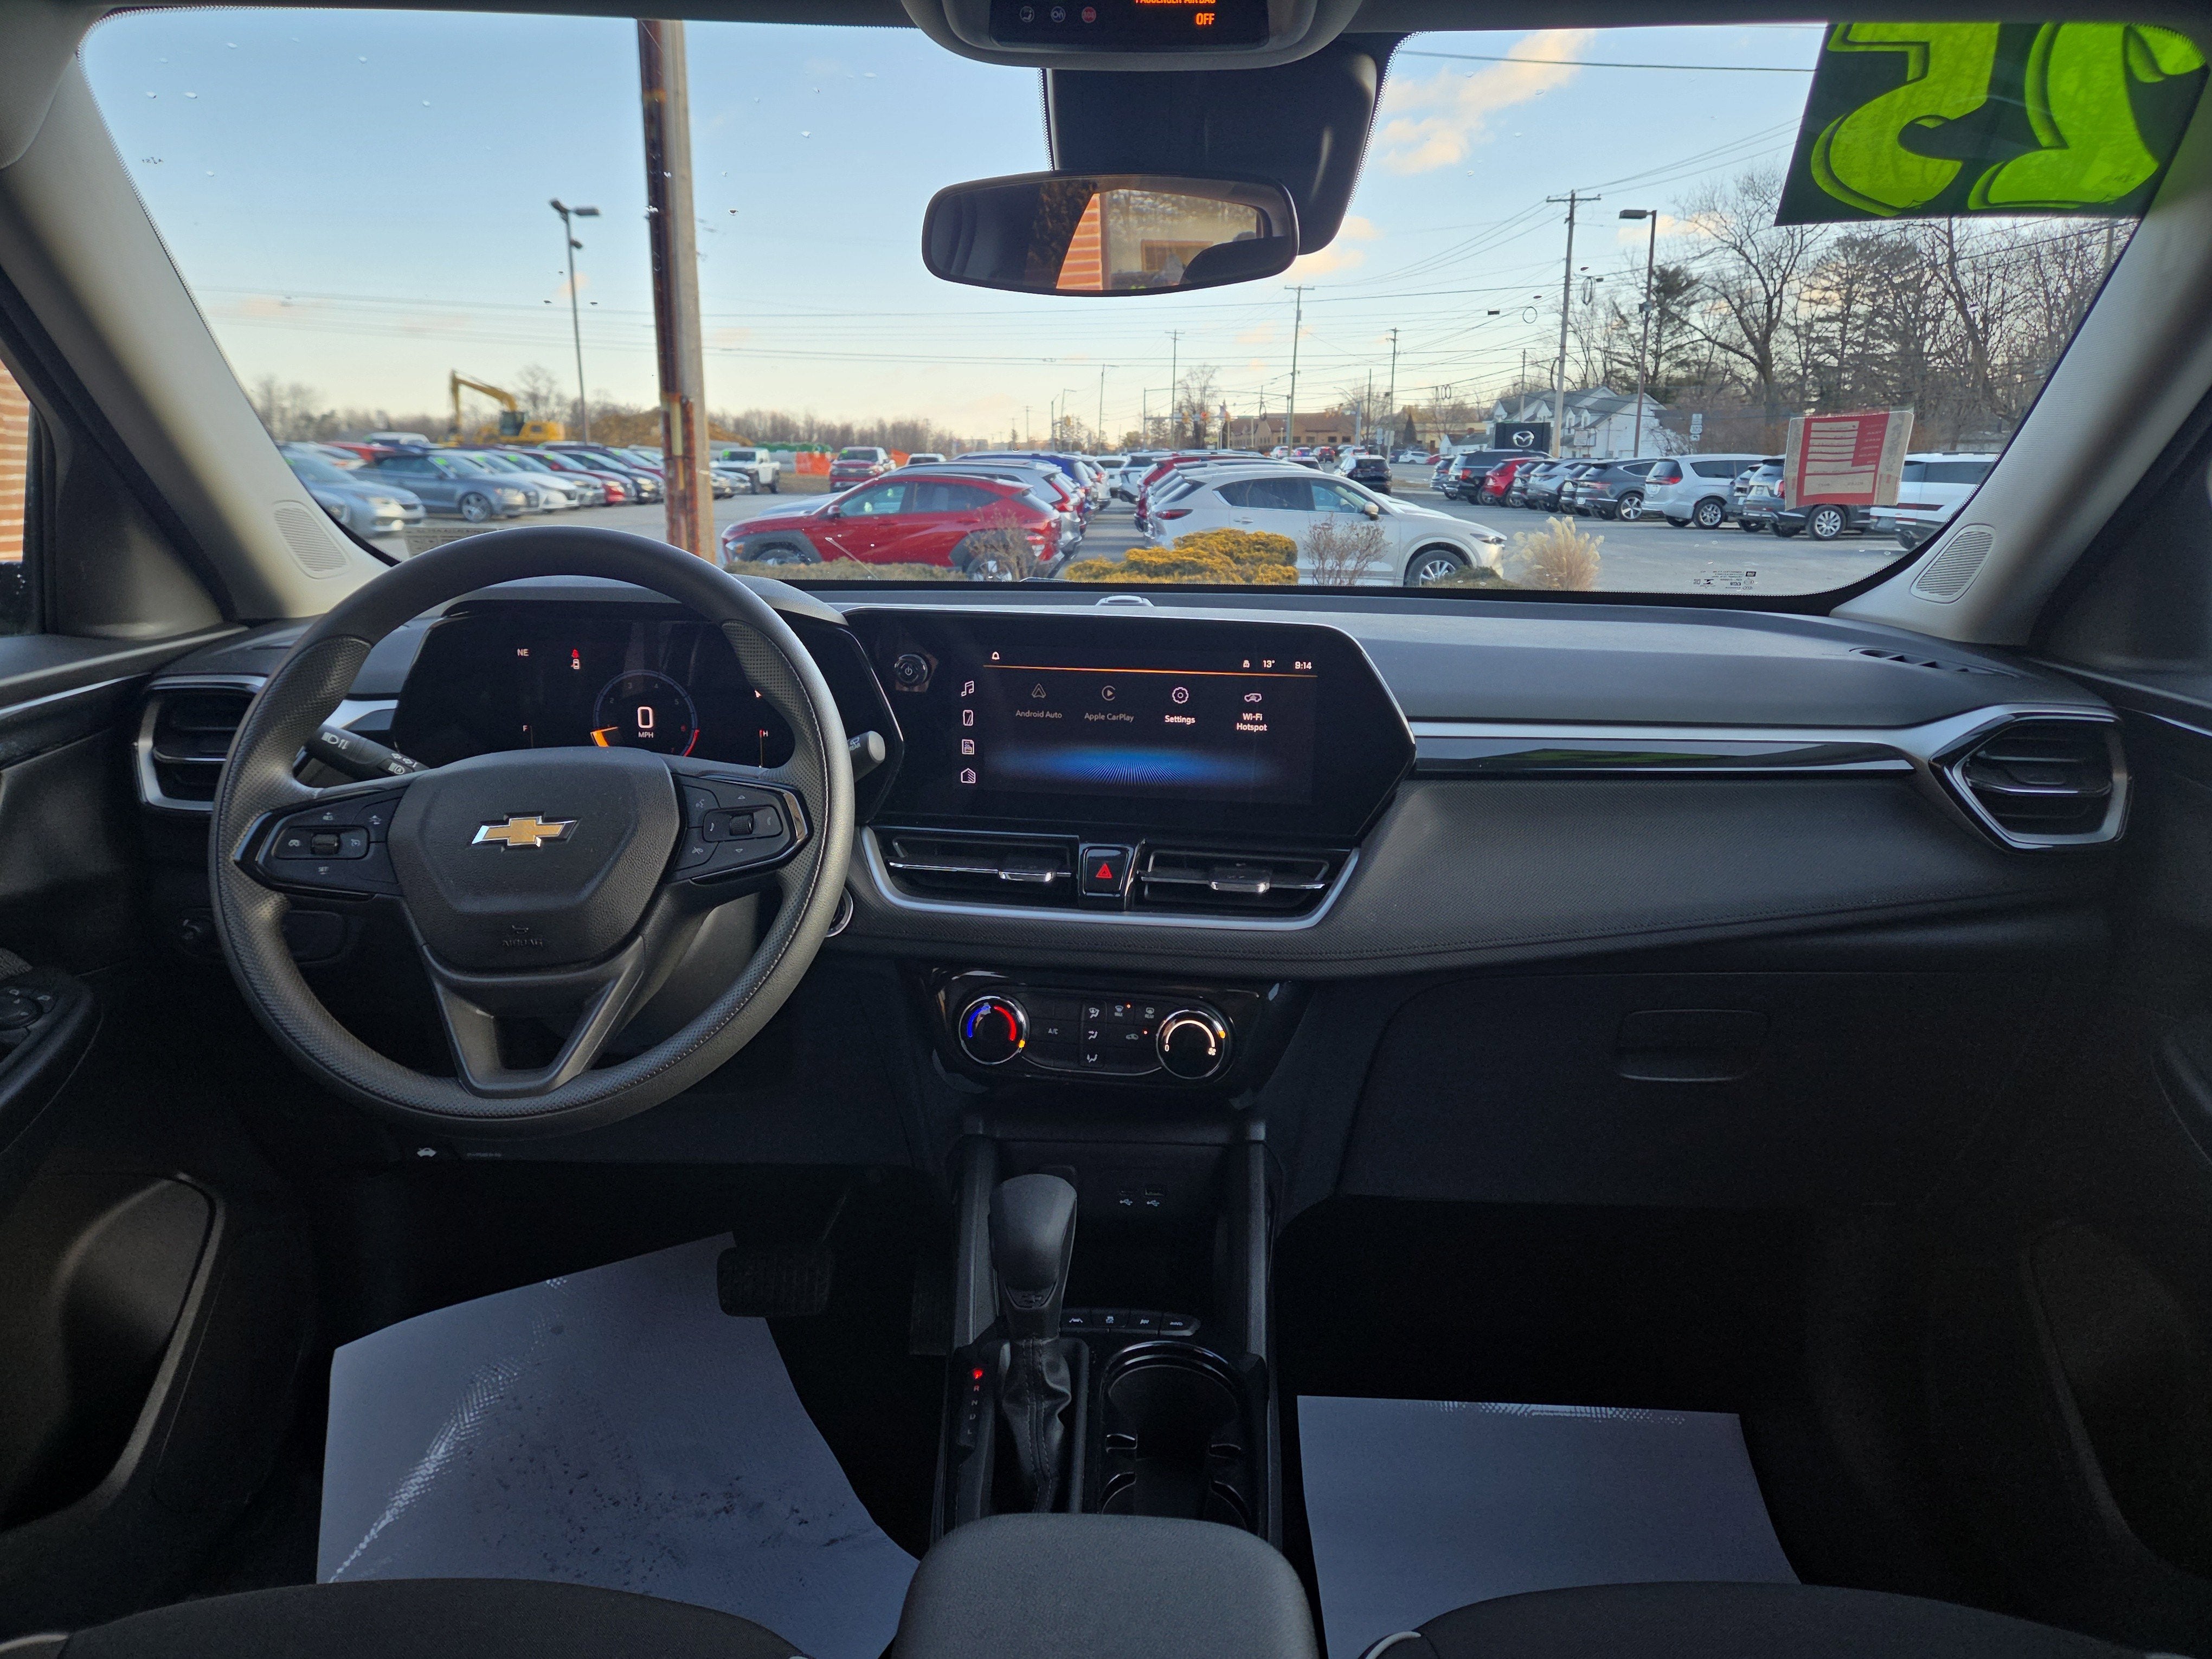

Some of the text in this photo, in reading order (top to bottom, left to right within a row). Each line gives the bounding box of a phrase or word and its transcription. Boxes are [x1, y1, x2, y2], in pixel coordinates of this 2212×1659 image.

[1196, 12, 1215, 25] OFF
[517, 648, 530, 657] NE
[636, 706, 654, 729] 0
[1015, 710, 1063, 719] Android Auto
[1084, 712, 1134, 723] Apple CarPlay
[1243, 712, 1263, 721] Wi-Fi
[1165, 715, 1195, 725] Settings
[1236, 722, 1268, 732] Hotspot
